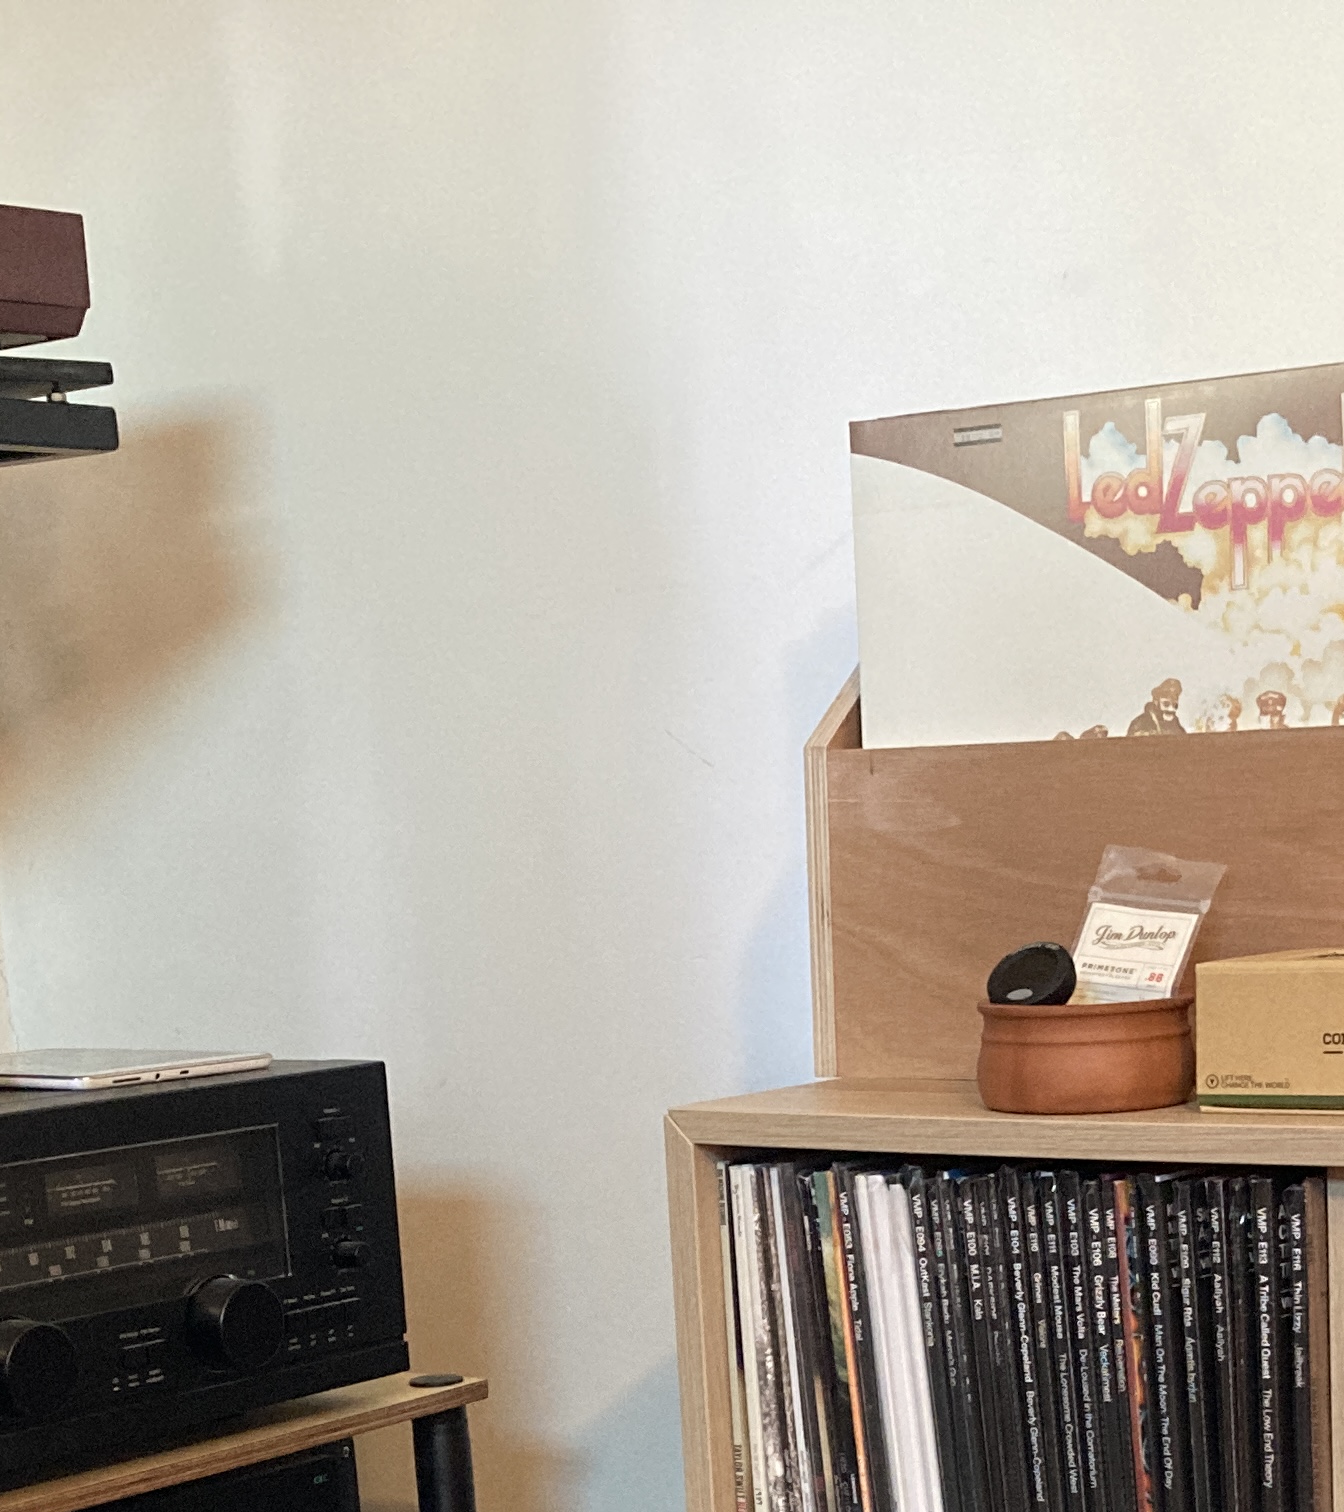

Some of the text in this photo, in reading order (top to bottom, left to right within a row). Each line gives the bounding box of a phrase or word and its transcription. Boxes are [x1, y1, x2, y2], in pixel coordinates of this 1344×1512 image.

[1063, 397, 1165, 523] Led
[1092, 924, 1176, 945] Jim Dunlop
[962, 1199, 973, 1223] VMP
[1026, 1204, 1037, 1226] VMP
[1088, 1208, 1099, 1232] VMP
[1145, 1205, 1156, 1230] VMP
[838, 1192, 850, 1215] VMP
[847, 1283, 859, 1311] Apple
[911, 1194, 922, 1218] VMP
[918, 1257, 930, 1297] OutKast
[966, 1232, 978, 1256] E100
[1009, 1230, 1020, 1254] E104
[1069, 1231, 1080, 1256] E103
[1091, 1242, 1102, 1266] E106
[1011, 1262, 1025, 1301] Beverly
[1050, 1265, 1063, 1303] Modest
[1093, 1274, 1106, 1309] Grizzly
[1150, 1272, 1161, 1290] Kid
[1180, 1277, 1192, 1305] Sigur
[1212, 1273, 1224, 1314] Aaliyah
[1054, 1305, 1065, 1339] Mouse
[1097, 1311, 1108, 1335] Bear
[1260, 1313, 1271, 1345] Called
[1292, 1305, 1304, 1333] Lizzy
[1025, 1390, 1038, 1425] Beverly
[1060, 1371, 1072, 1422] Lonesome
[1064, 1423, 1076, 1466] Crowded
[1162, 1471, 1174, 1489] Day
[1262, 1454, 1275, 1488] Theory
